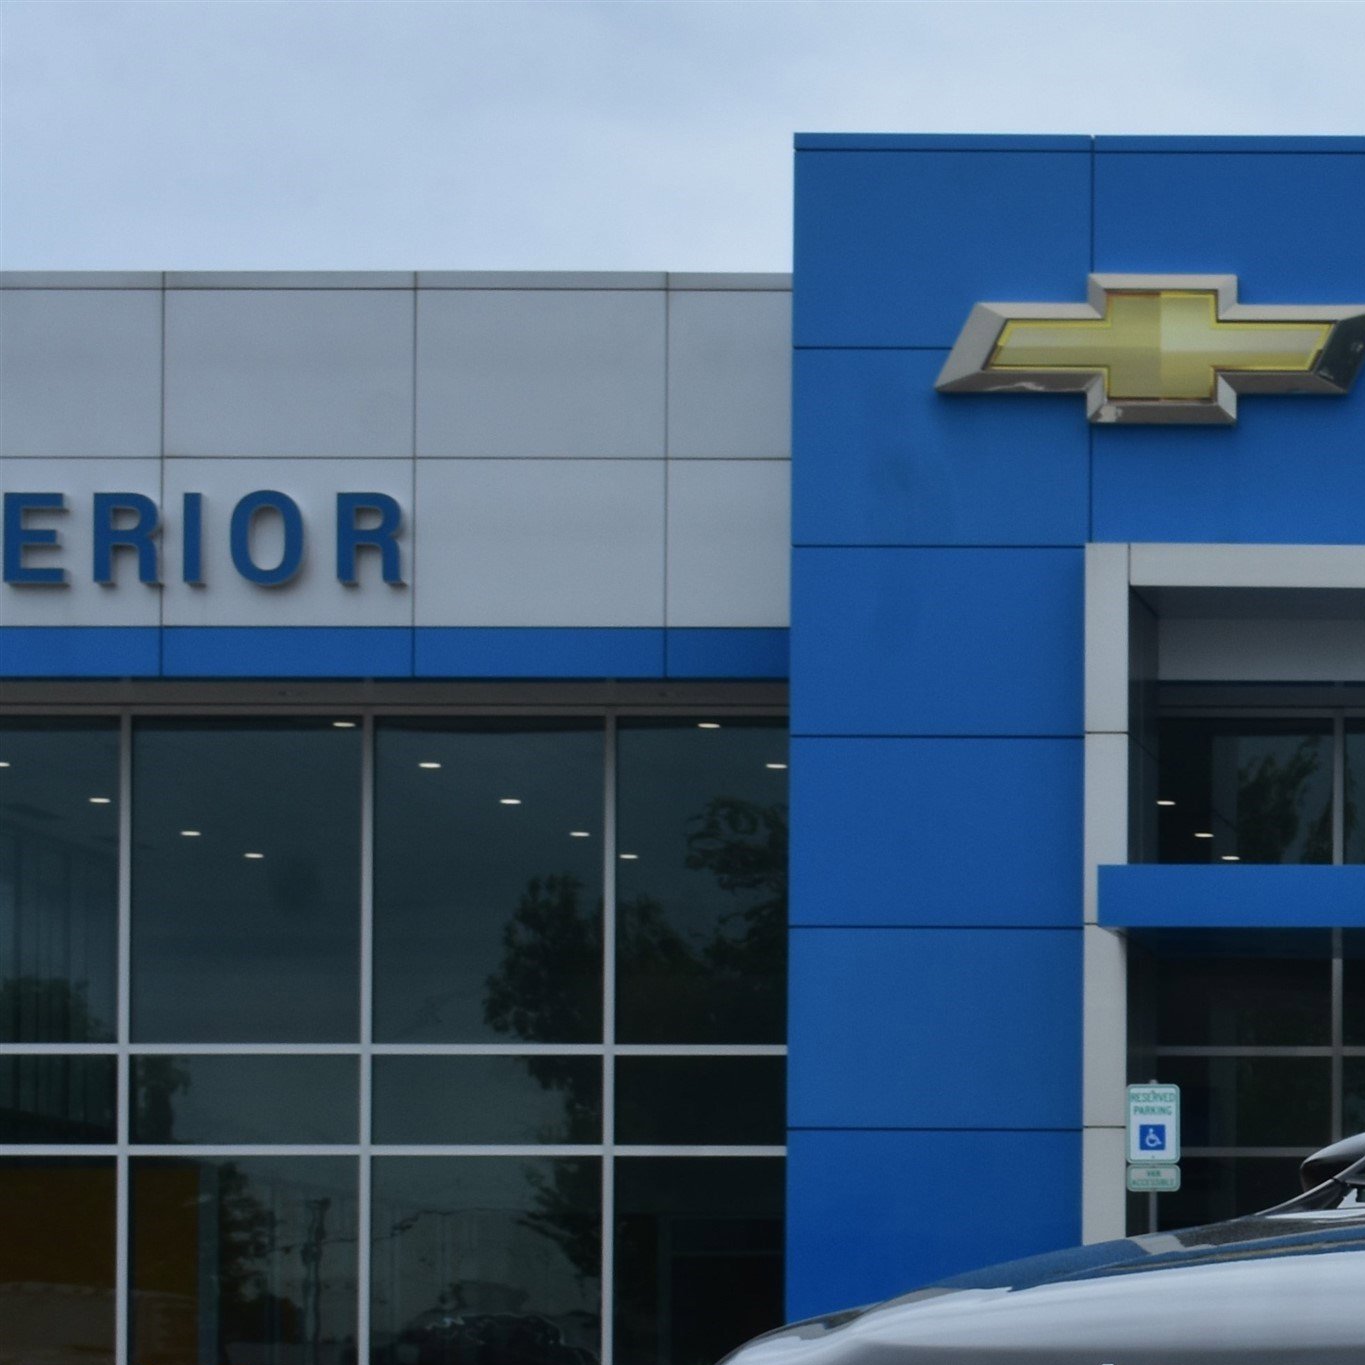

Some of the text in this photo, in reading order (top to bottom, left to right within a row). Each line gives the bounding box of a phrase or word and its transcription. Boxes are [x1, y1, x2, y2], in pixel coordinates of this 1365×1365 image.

[2, 489, 406, 588] ERIOR
[1130, 1092, 1175, 1102] RESERVED
[1133, 1105, 1173, 1115] PARKING
